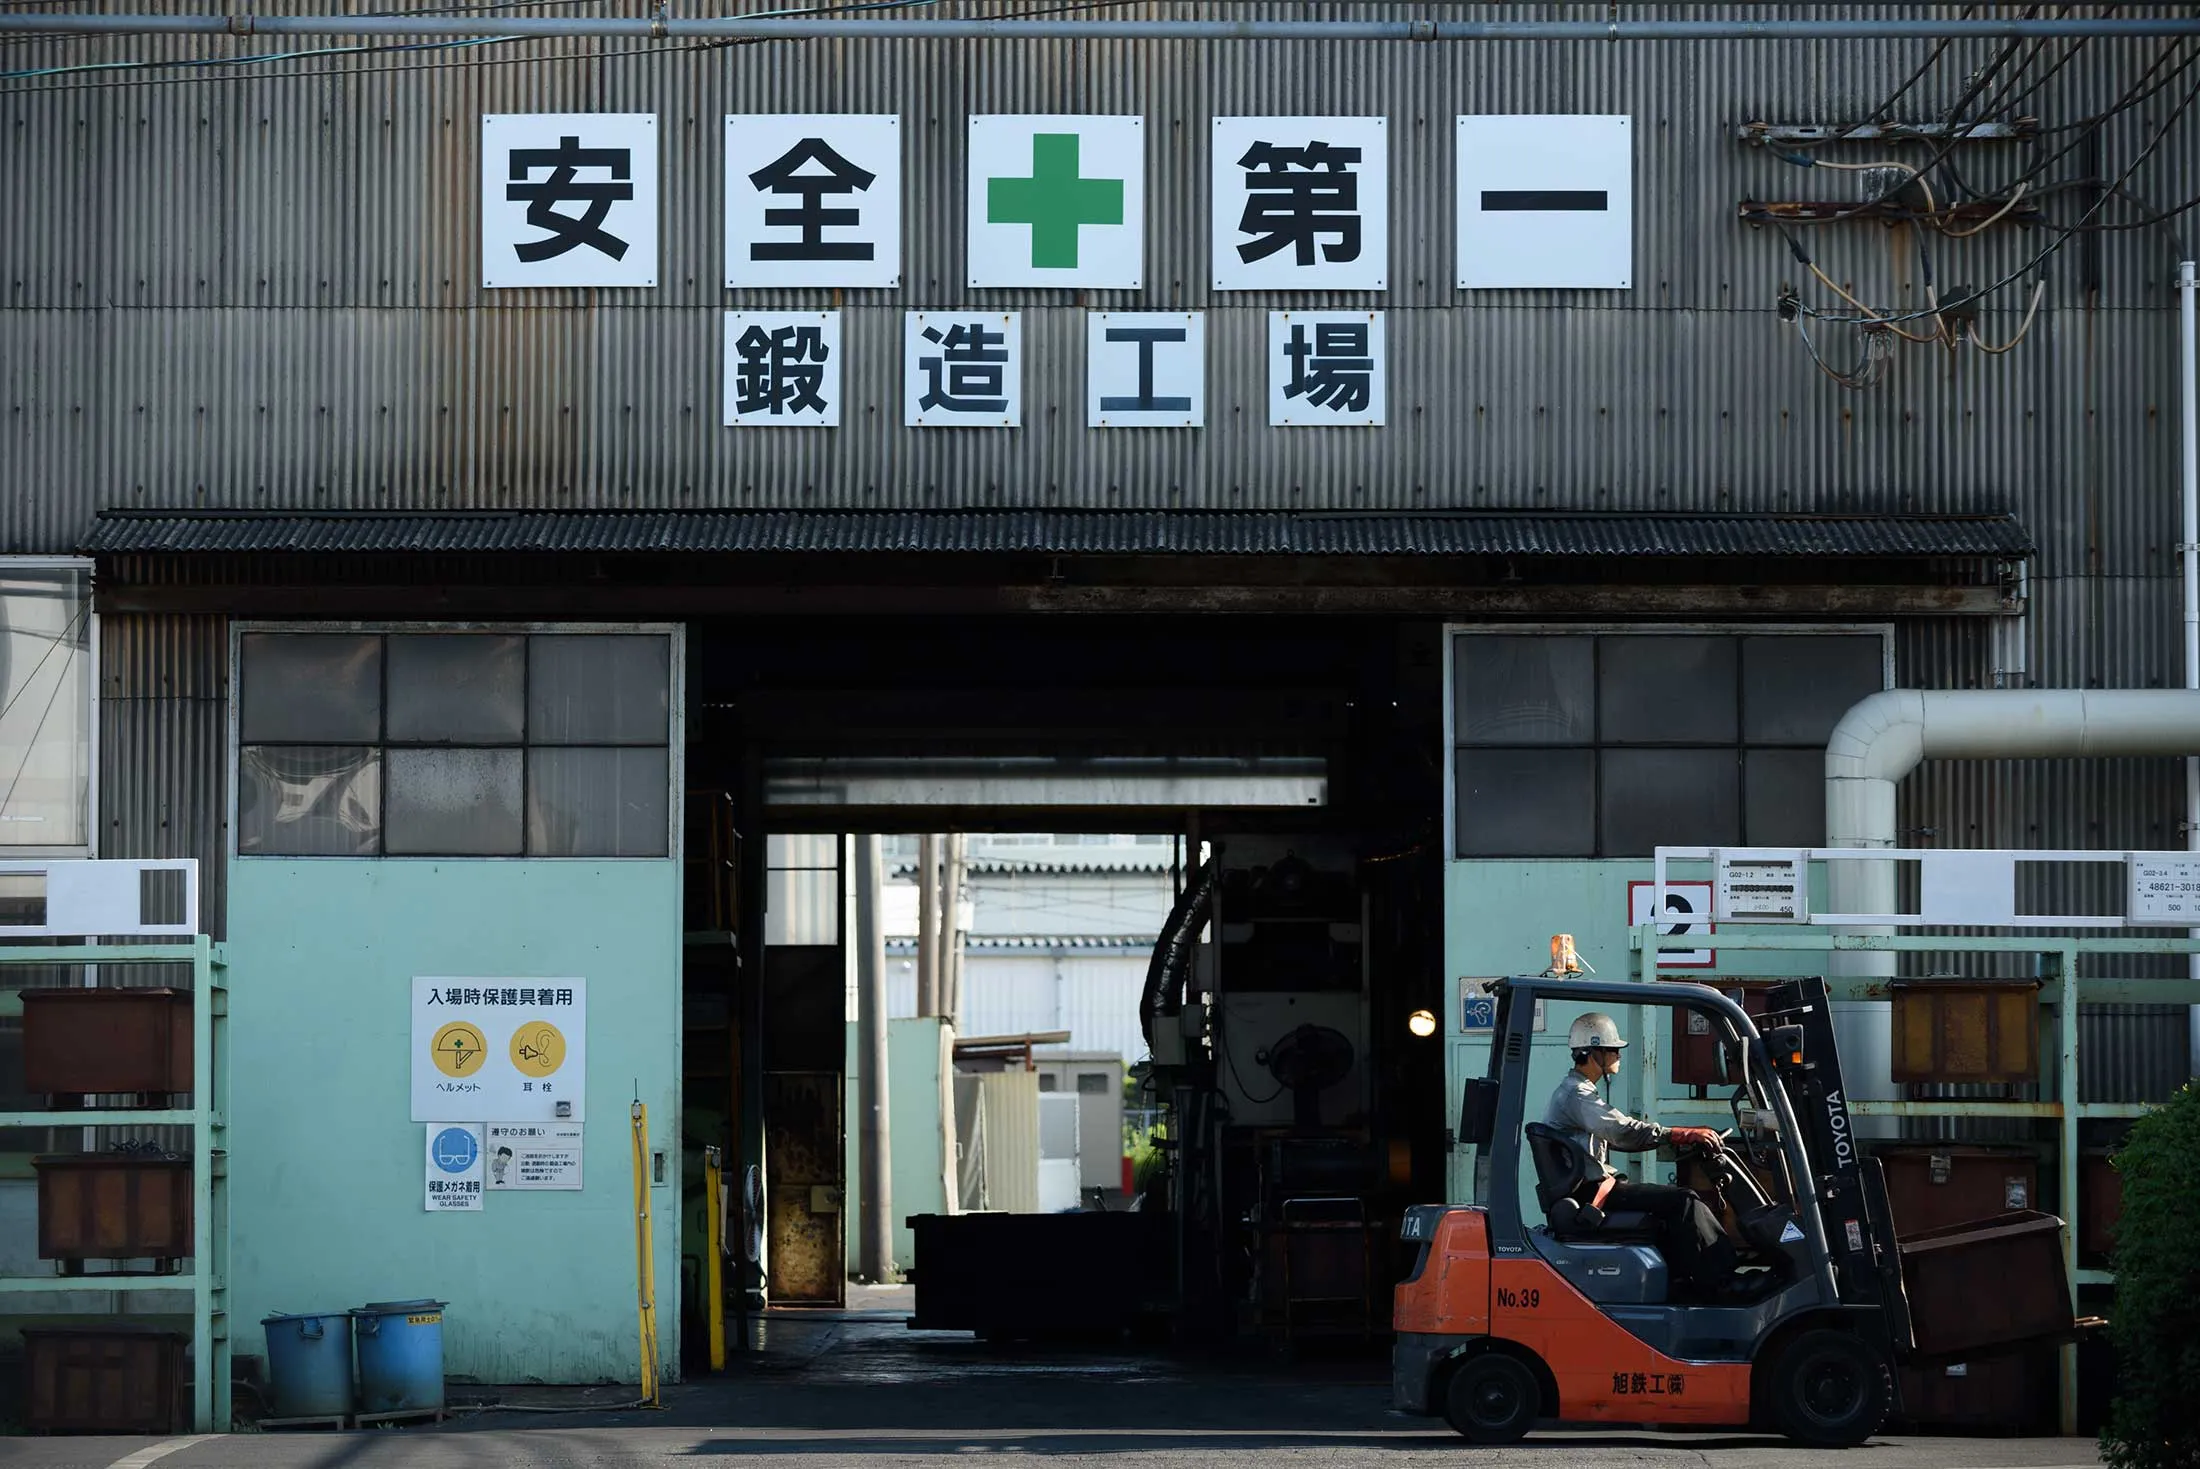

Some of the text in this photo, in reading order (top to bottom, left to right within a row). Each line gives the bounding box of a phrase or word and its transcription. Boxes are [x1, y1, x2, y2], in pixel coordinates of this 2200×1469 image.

[427, 988, 573, 1006] 入場時保護具着用
[436, 1082, 481, 1093] ヘルメット
[1826, 1090, 1853, 1169] TOYOTA
[429, 1181, 480, 1193] 保護メガネ着用
[1401, 1217, 1421, 1237] TA
[1497, 1288, 1540, 1308] No.39
